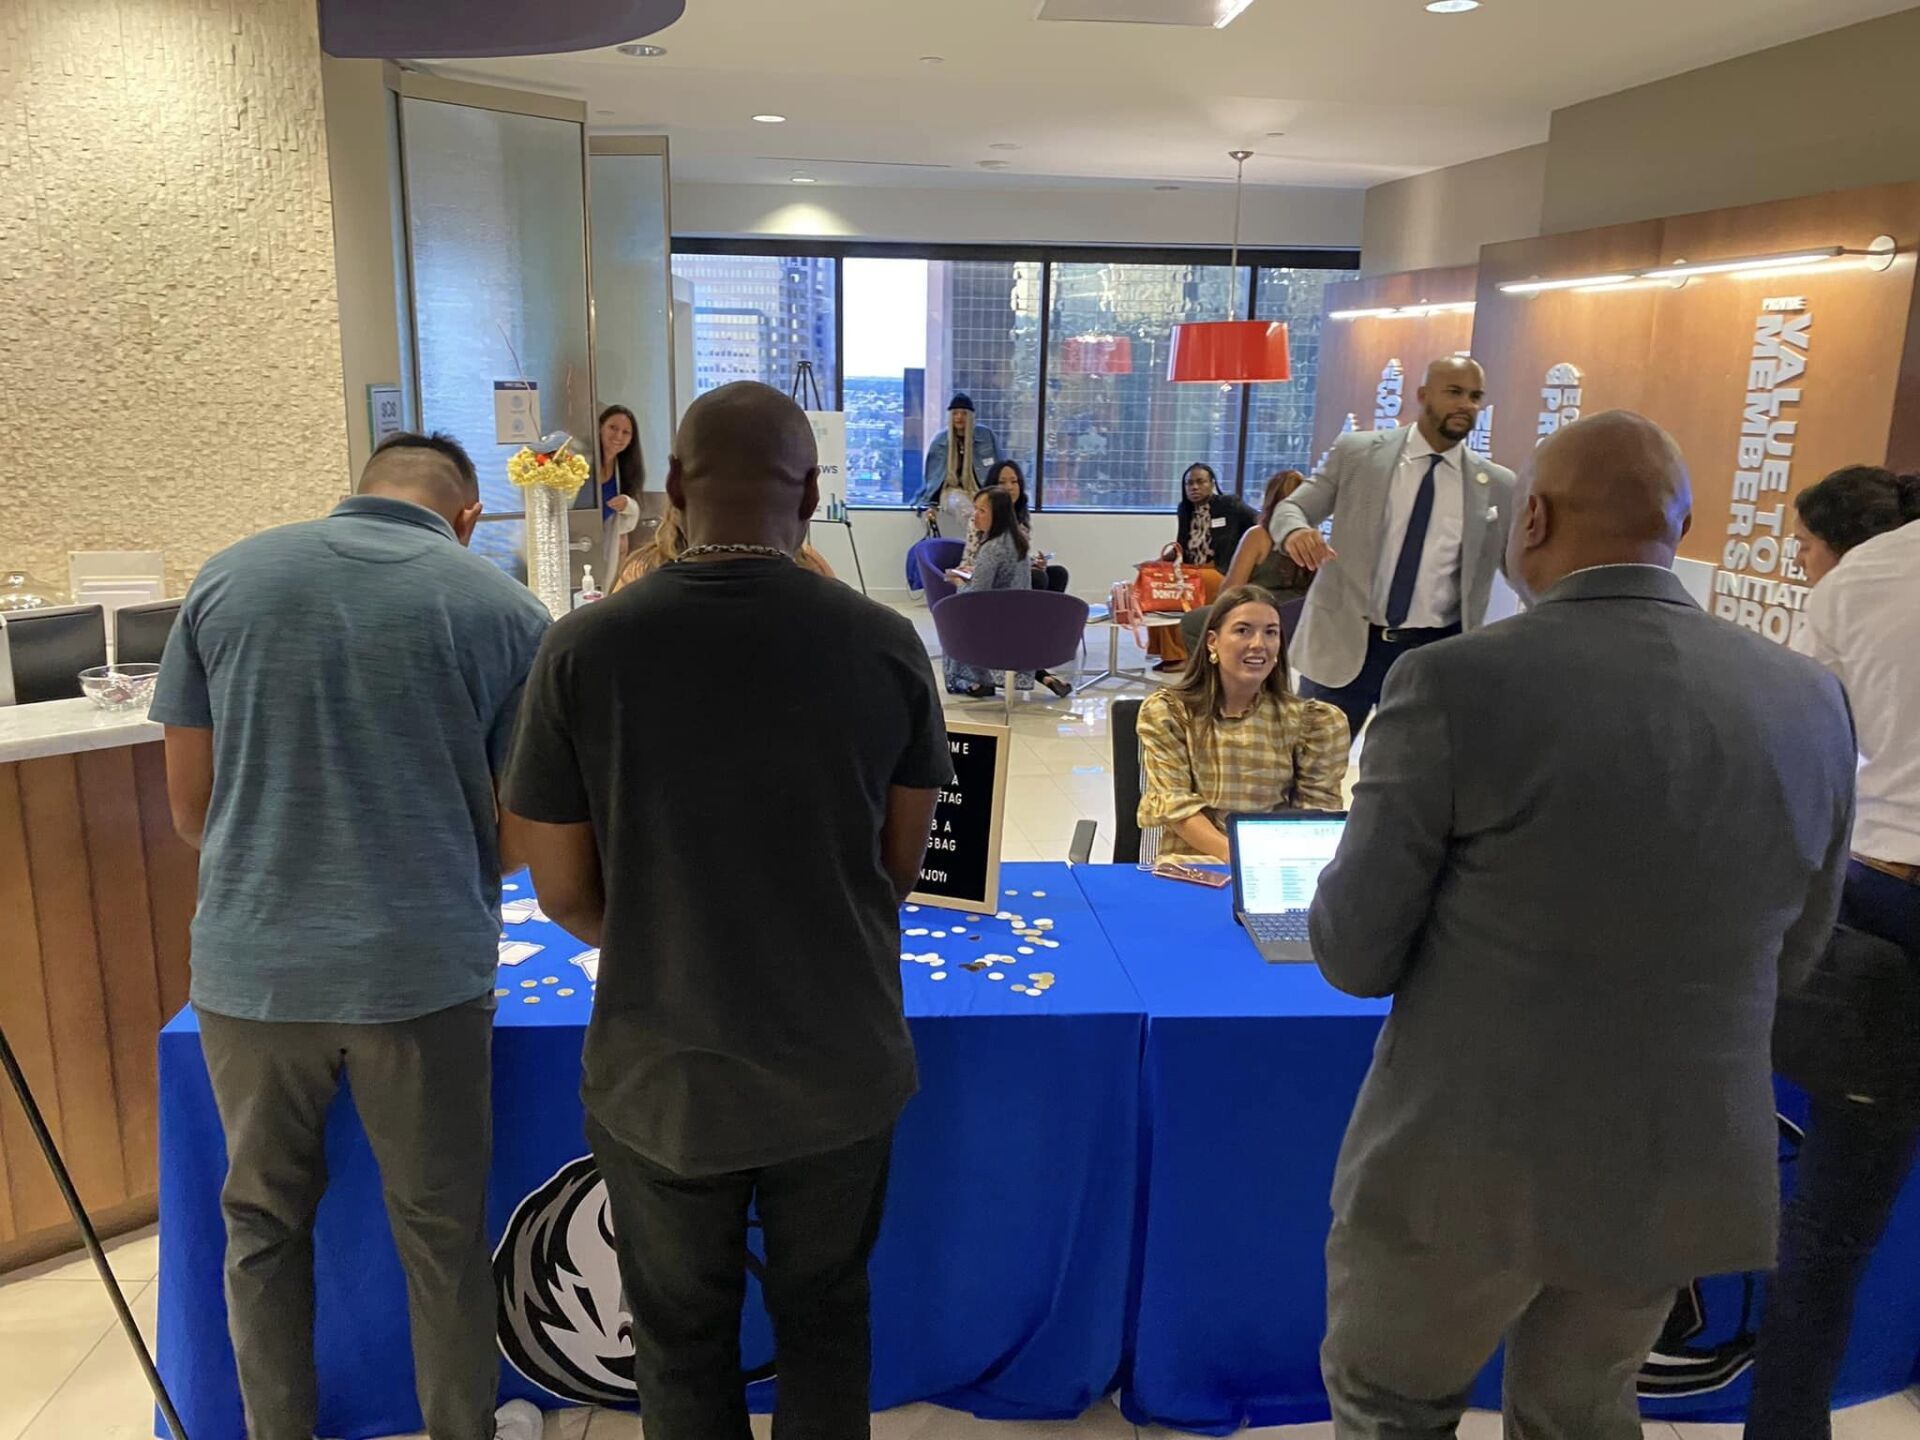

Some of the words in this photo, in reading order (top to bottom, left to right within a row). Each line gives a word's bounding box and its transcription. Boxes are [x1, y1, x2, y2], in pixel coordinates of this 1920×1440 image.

[1761, 313, 1811, 492] VALUE
[1723, 315, 1783, 570] MEMBERS
[1750, 504, 1784, 573] TO
[947, 740, 969, 755] ME
[951, 774, 959, 786] A
[943, 820, 951, 833] A
